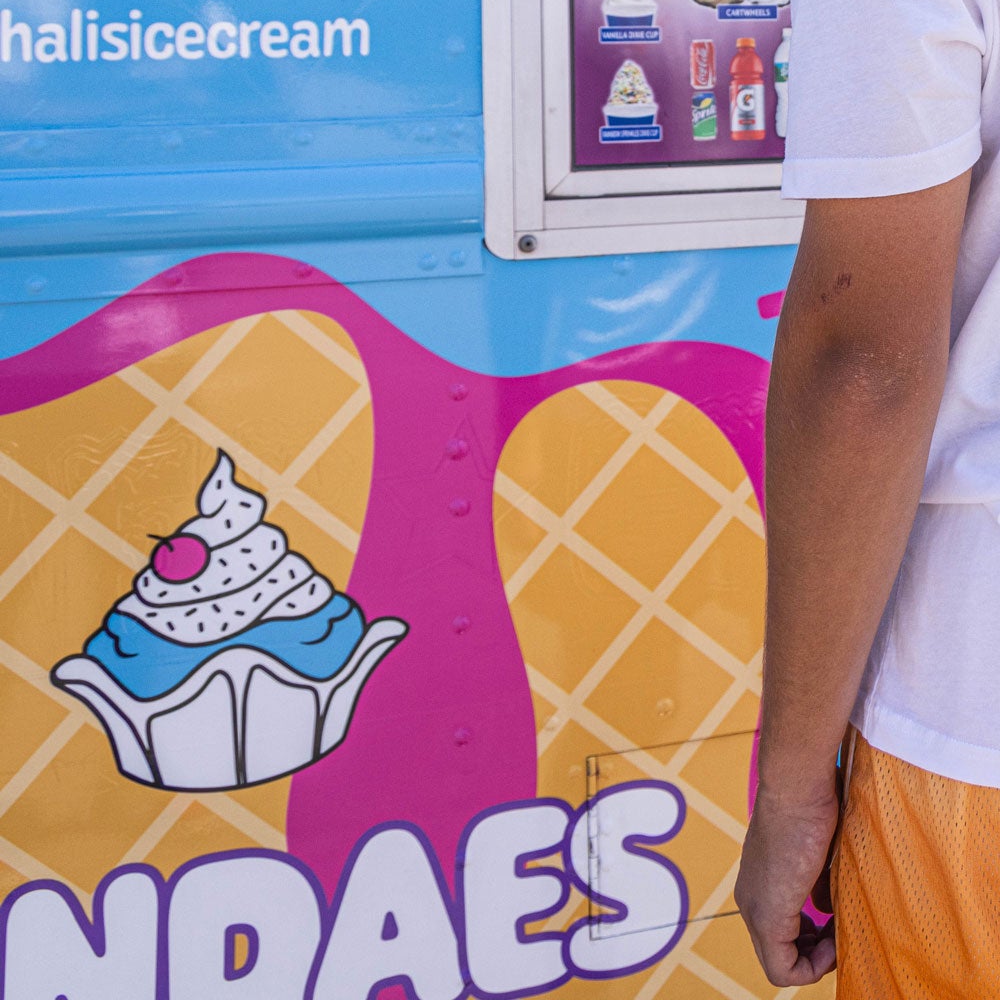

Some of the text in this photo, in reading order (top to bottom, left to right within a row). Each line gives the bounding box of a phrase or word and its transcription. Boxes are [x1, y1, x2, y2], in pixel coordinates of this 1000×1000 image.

[1, 8, 370, 63] halisicecream
[725, 8, 771, 17] CARTWHEELS
[2, 780, 688, 1000] NDAES
